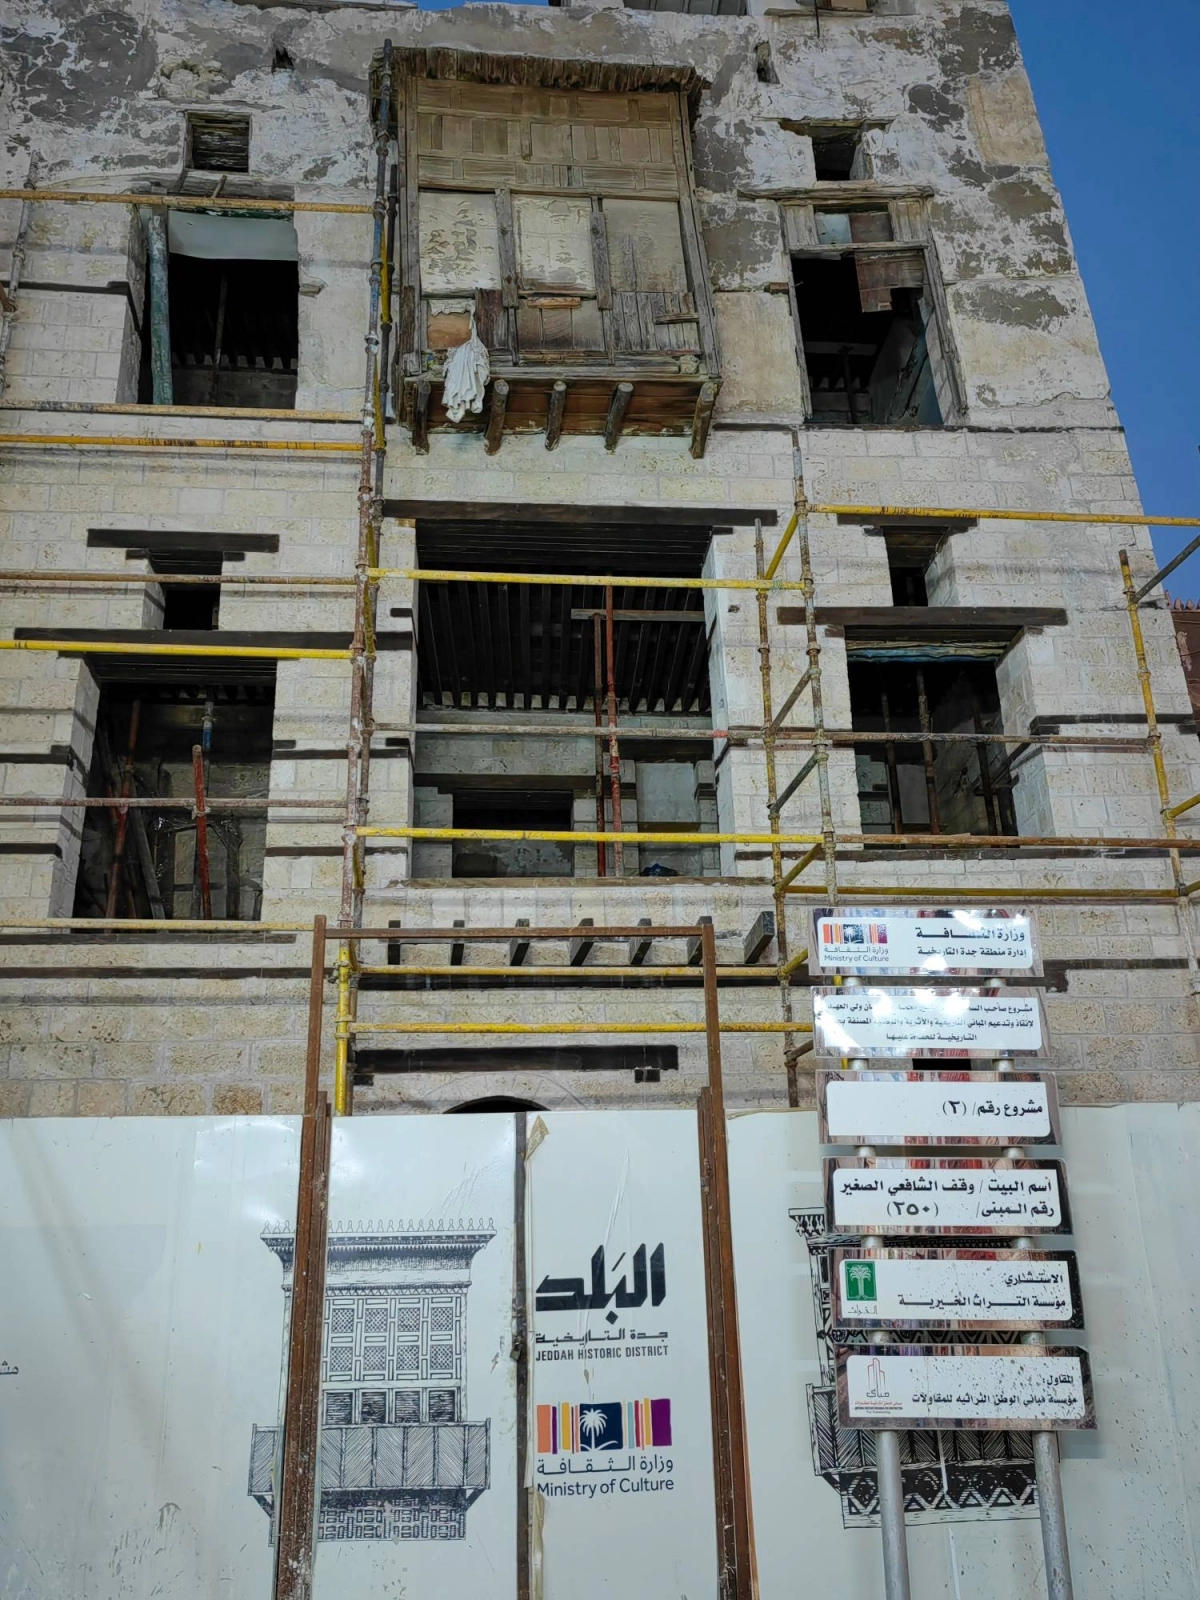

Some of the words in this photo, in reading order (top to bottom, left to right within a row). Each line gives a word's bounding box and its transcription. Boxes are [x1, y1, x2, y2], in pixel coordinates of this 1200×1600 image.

[997, 928, 1024, 942] وزارة
[824, 945, 870, 954] الثقافة
[873, 946, 889, 955] وزارة
[960, 948, 977, 957] جدة
[980, 948, 1006, 956] منطقة
[1007, 948, 1026, 958] إدارة
[824, 954, 852, 963] Ministry
[864, 954, 890, 962] Culture
[850, 1003, 862, 1012] ولي
[984, 1004, 1006, 1014] صاحب
[1008, 1003, 1033, 1014] مشروع
[846, 1016, 872, 1024] المصنفة
[967, 1018, 986, 1028] المباني
[988, 1019, 1014, 1028] وتدعيم
[936, 1032, 977, 1042] التاريخية
[1004, 1099, 1043, 1116] مشروع
[840, 1178, 884, 1195] الصغير
[888, 1176, 938, 1196] الشافعي
[942, 1178, 975, 1194] وقف
[989, 1180, 1024, 1196] البيت
[1030, 1202, 1055, 1217] رقم
[1004, 1272, 1064, 1287] الاستشاري
[898, 1294, 971, 1310] الخيرية
[973, 1294, 1030, 1307] التراث
[1033, 1294, 1066, 1308] مؤسسة
[535, 1328, 625, 1348] التاريخية
[630, 1328, 668, 1342] جدة
[536, 1349, 574, 1362] JEDDAH
[578, 1347, 622, 1360] HISTORIC
[626, 1345, 669, 1358] DISTRICT
[912, 1394, 953, 1404] للمقاولات
[994, 1394, 1020, 1406] الوطن
[1048, 1394, 1078, 1404] مؤسسة
[537, 1456, 636, 1475] الثقافة
[640, 1455, 674, 1474] وزارة
[538, 1480, 597, 1499] Ministry
[600, 1478, 616, 1494] of
[620, 1477, 674, 1493] Culture
